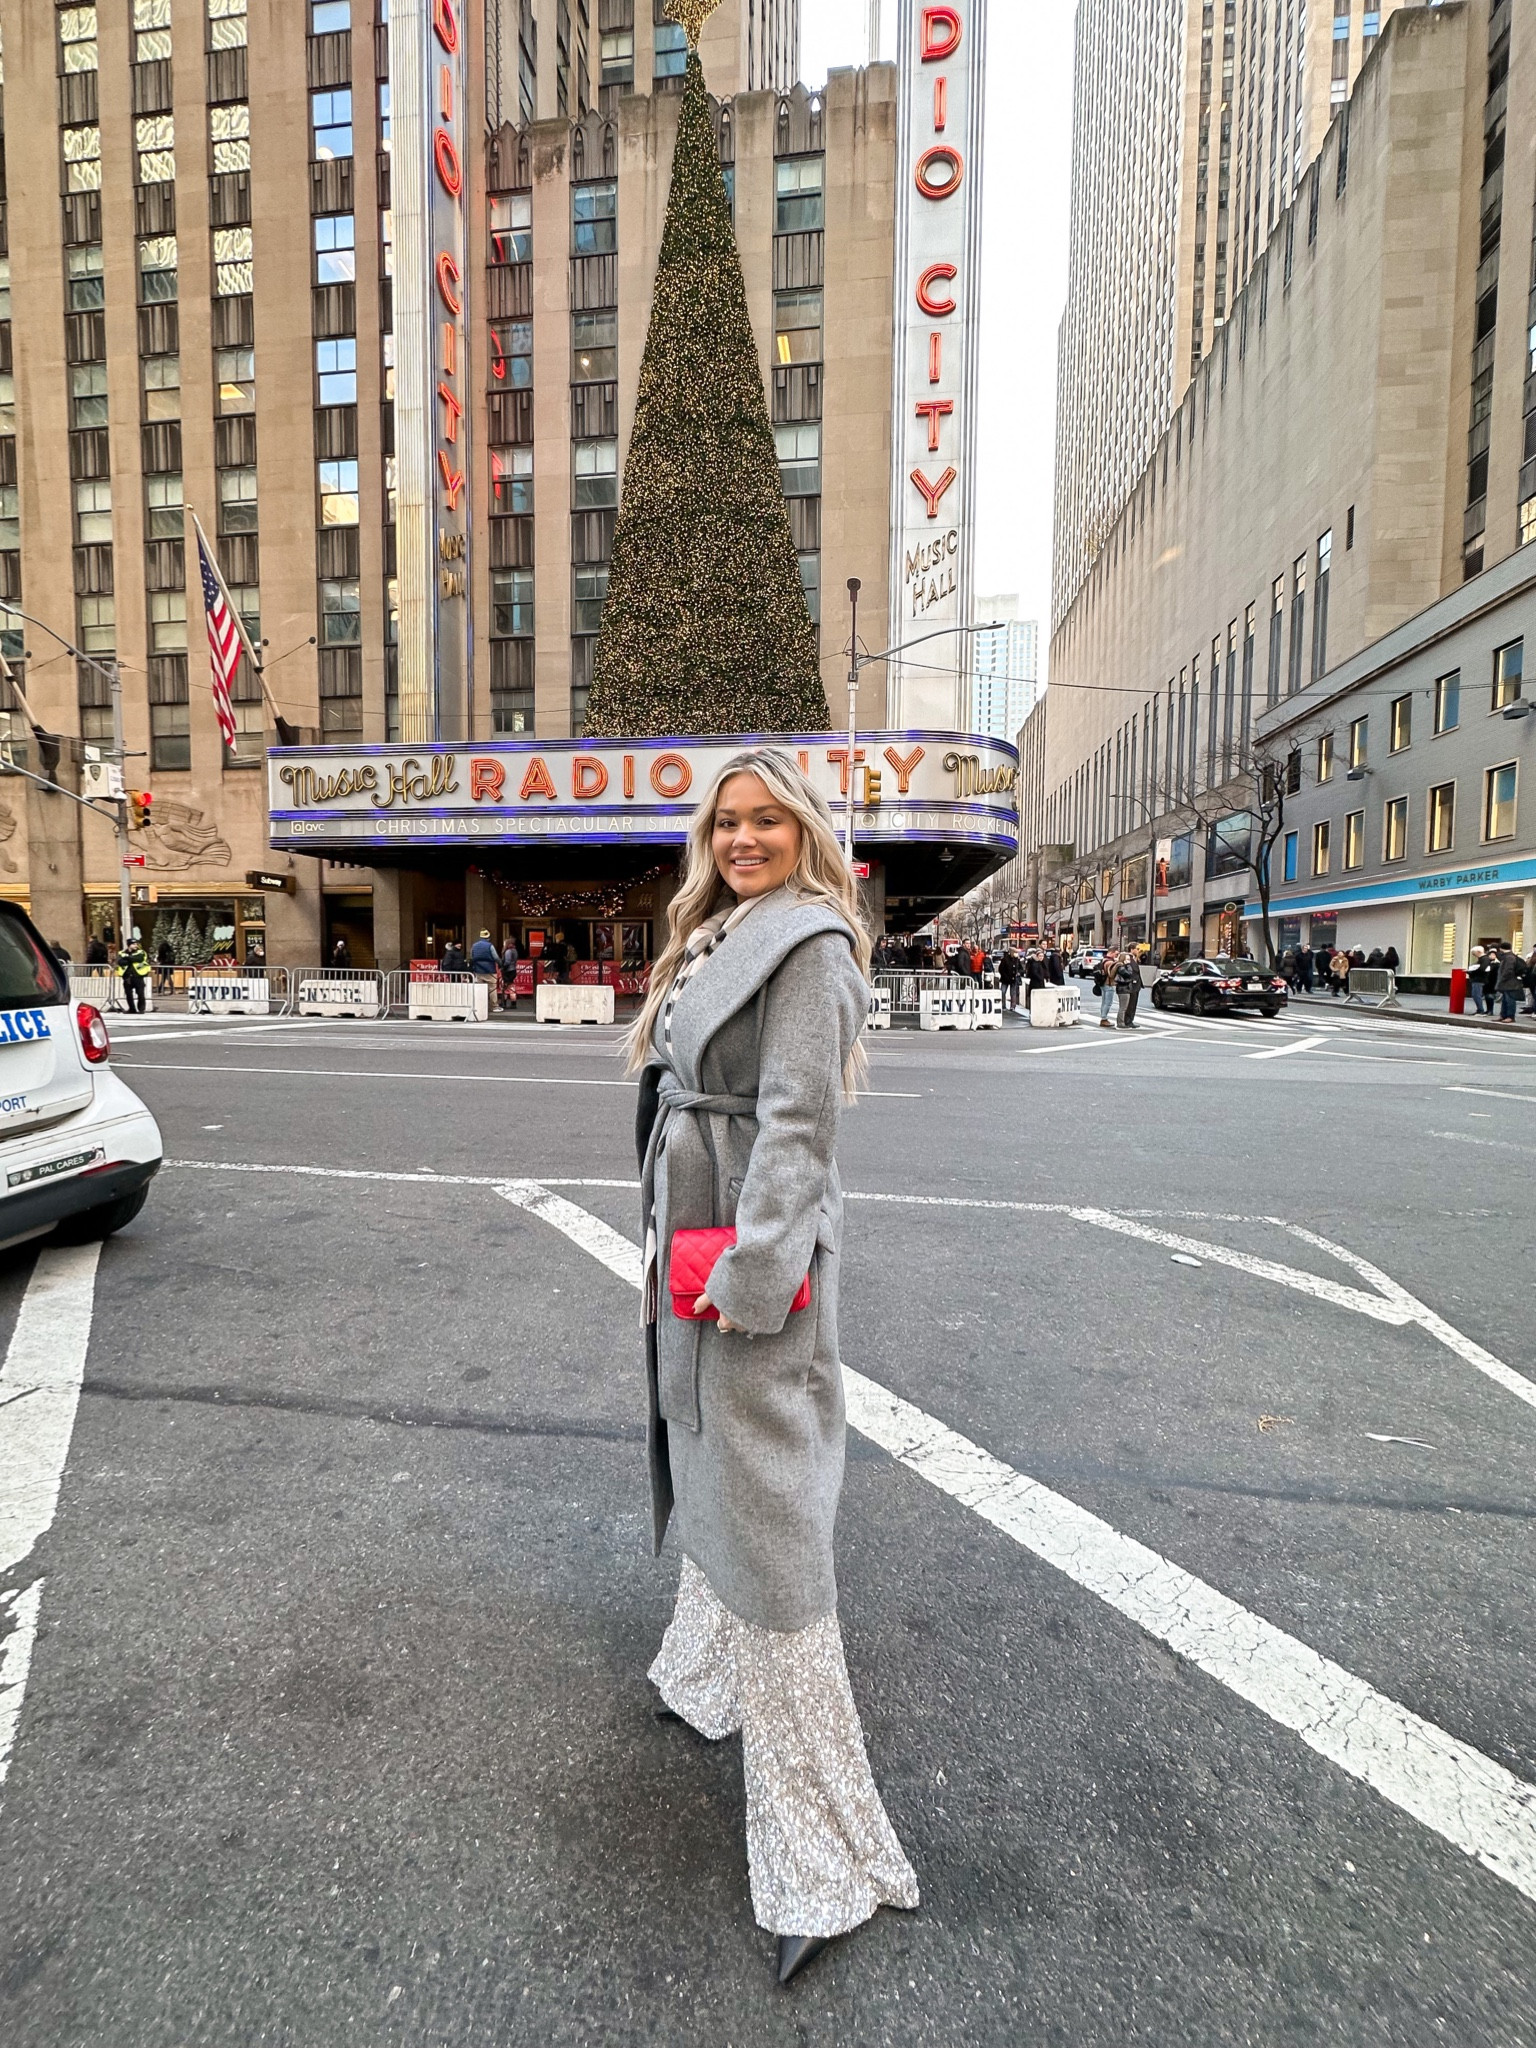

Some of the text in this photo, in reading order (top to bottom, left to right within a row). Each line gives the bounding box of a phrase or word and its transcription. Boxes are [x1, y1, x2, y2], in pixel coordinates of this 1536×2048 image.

[911, 5, 965, 520] DIO CITY
[437, 251, 461, 512] CITY
[906, 530, 957, 584] MUSIC
[913, 568, 956, 616] HALL
[280, 754, 460, 807] Music Hall
[471, 753, 693, 802] RADIO
[798, 746, 925, 794] ITY
[376, 818, 480, 834] CHRISTMAS
[495, 816, 633, 833] SPECTACULAR
[891, 813, 938, 828] CITY
[1419, 870, 1499, 889] WARBY PARKER
[941, 998, 993, 1014] NYPD
[0, 1095, 26, 1112] ORT
[39, 1165, 55, 1175] PAL
[56, 1156, 84, 1170] CARES
